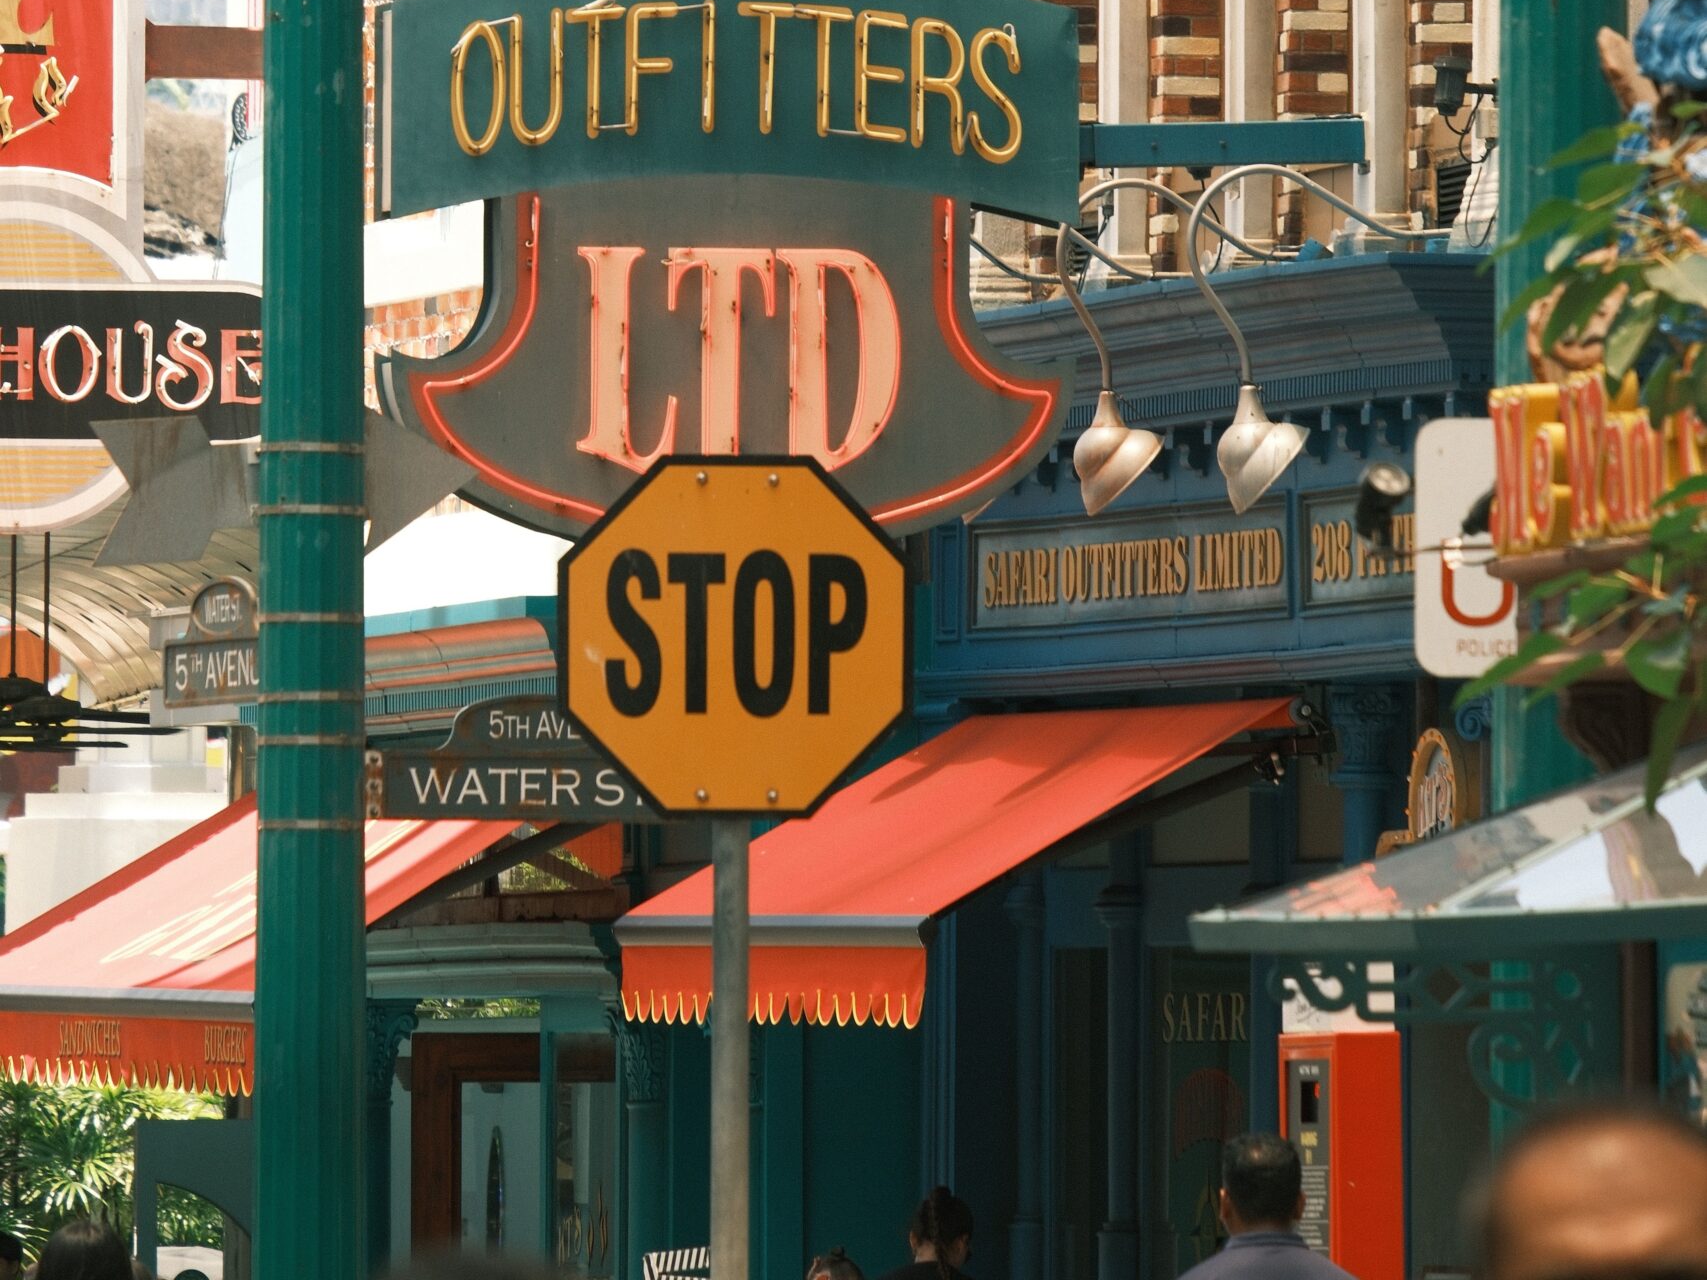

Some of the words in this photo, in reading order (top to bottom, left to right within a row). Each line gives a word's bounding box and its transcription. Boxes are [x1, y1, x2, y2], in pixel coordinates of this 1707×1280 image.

[0, 319, 263, 411] HOUSE
[576, 246, 901, 475] LTD
[984, 548, 1059, 608] SAFARI
[1061, 535, 1189, 603] OUTFITTERS
[1194, 527, 1283, 593] LIMITED
[1312, 520, 1352, 582] 208
[604, 547, 869, 719] STOP
[174, 652, 203, 691] 5TH
[204, 648, 260, 689] AVENU
[489, 710, 530, 740] 5TH
[409, 767, 581, 806] WATER
[594, 769, 644, 807] S
[59, 1020, 122, 1058] SANDWICHES
[204, 1024, 248, 1065] BURGERS
[1162, 991, 1248, 1044] SAFAR
